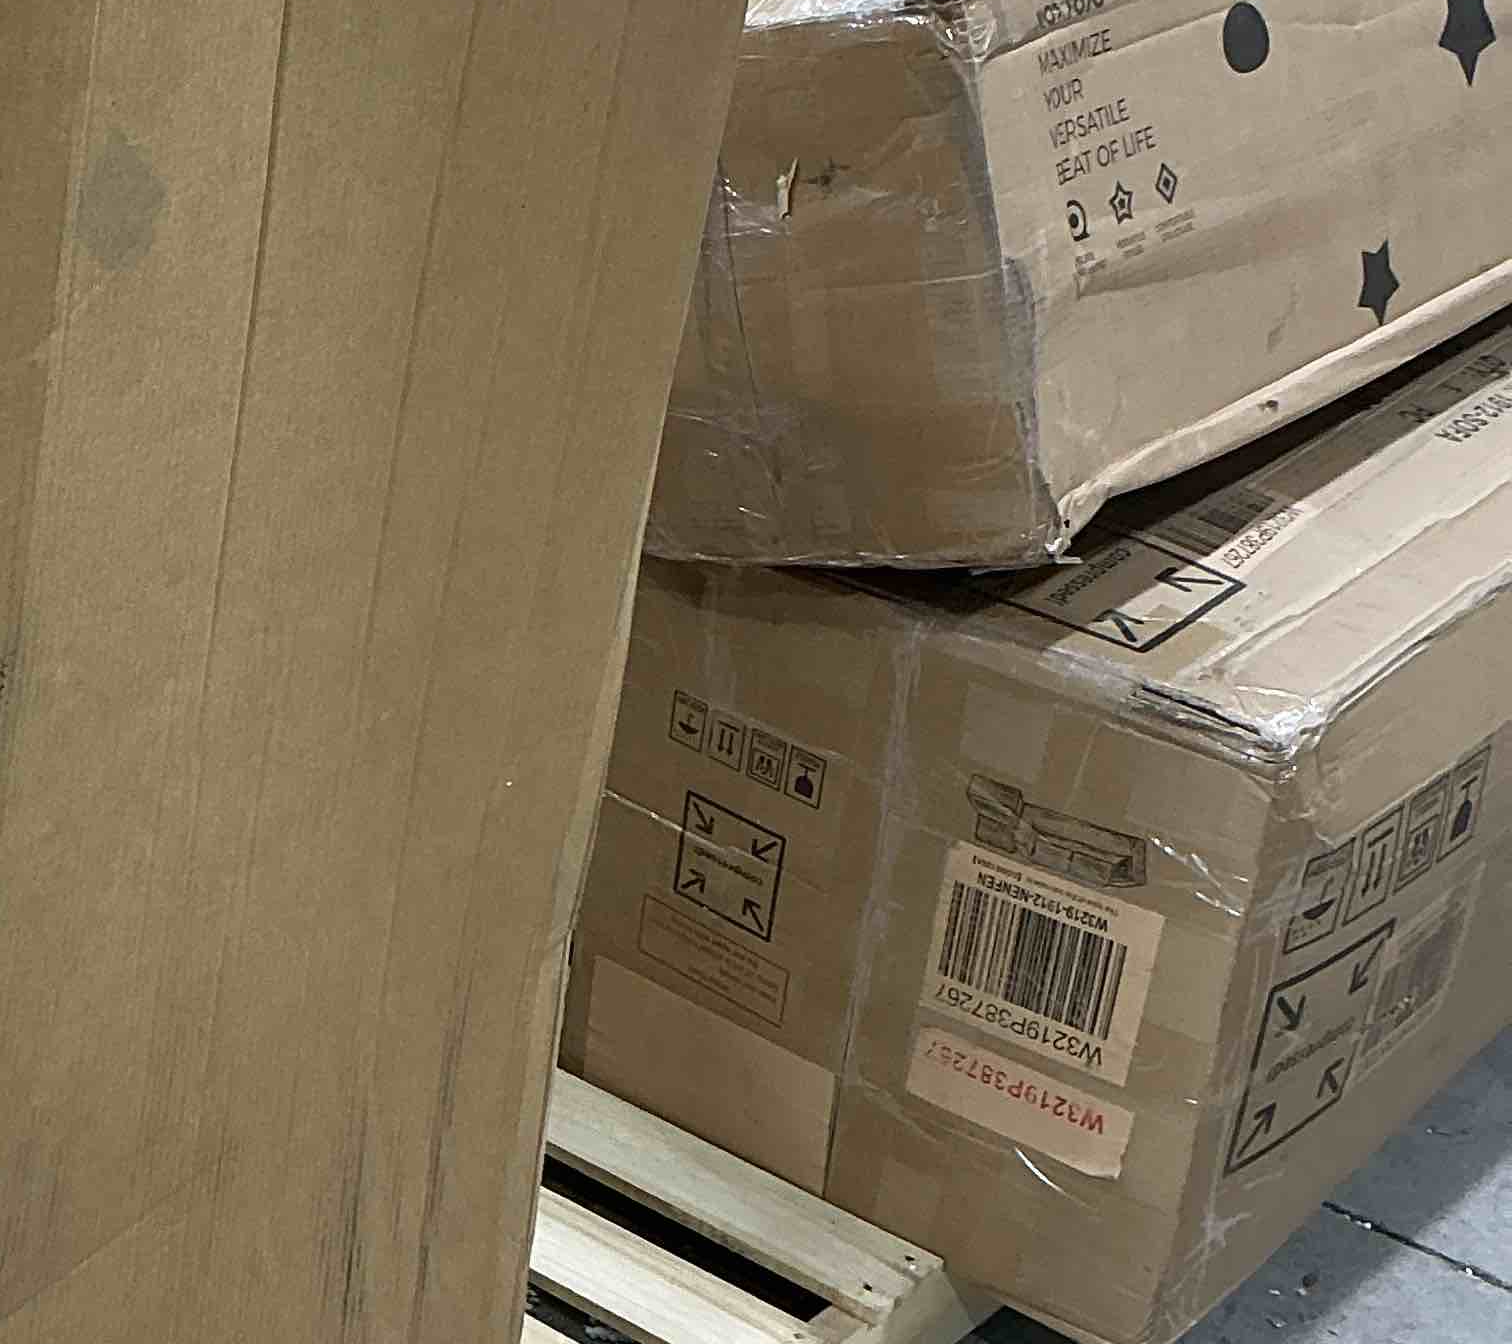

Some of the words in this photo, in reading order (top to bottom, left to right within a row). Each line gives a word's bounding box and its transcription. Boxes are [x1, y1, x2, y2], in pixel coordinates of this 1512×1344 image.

[1038, 29, 1112, 72] MAXIMIZE
[1044, 79, 1083, 111] YOUR
[1049, 99, 1130, 148] VERSATILE
[1096, 140, 1118, 167] OF
[1122, 126, 1156, 158] LIFE
